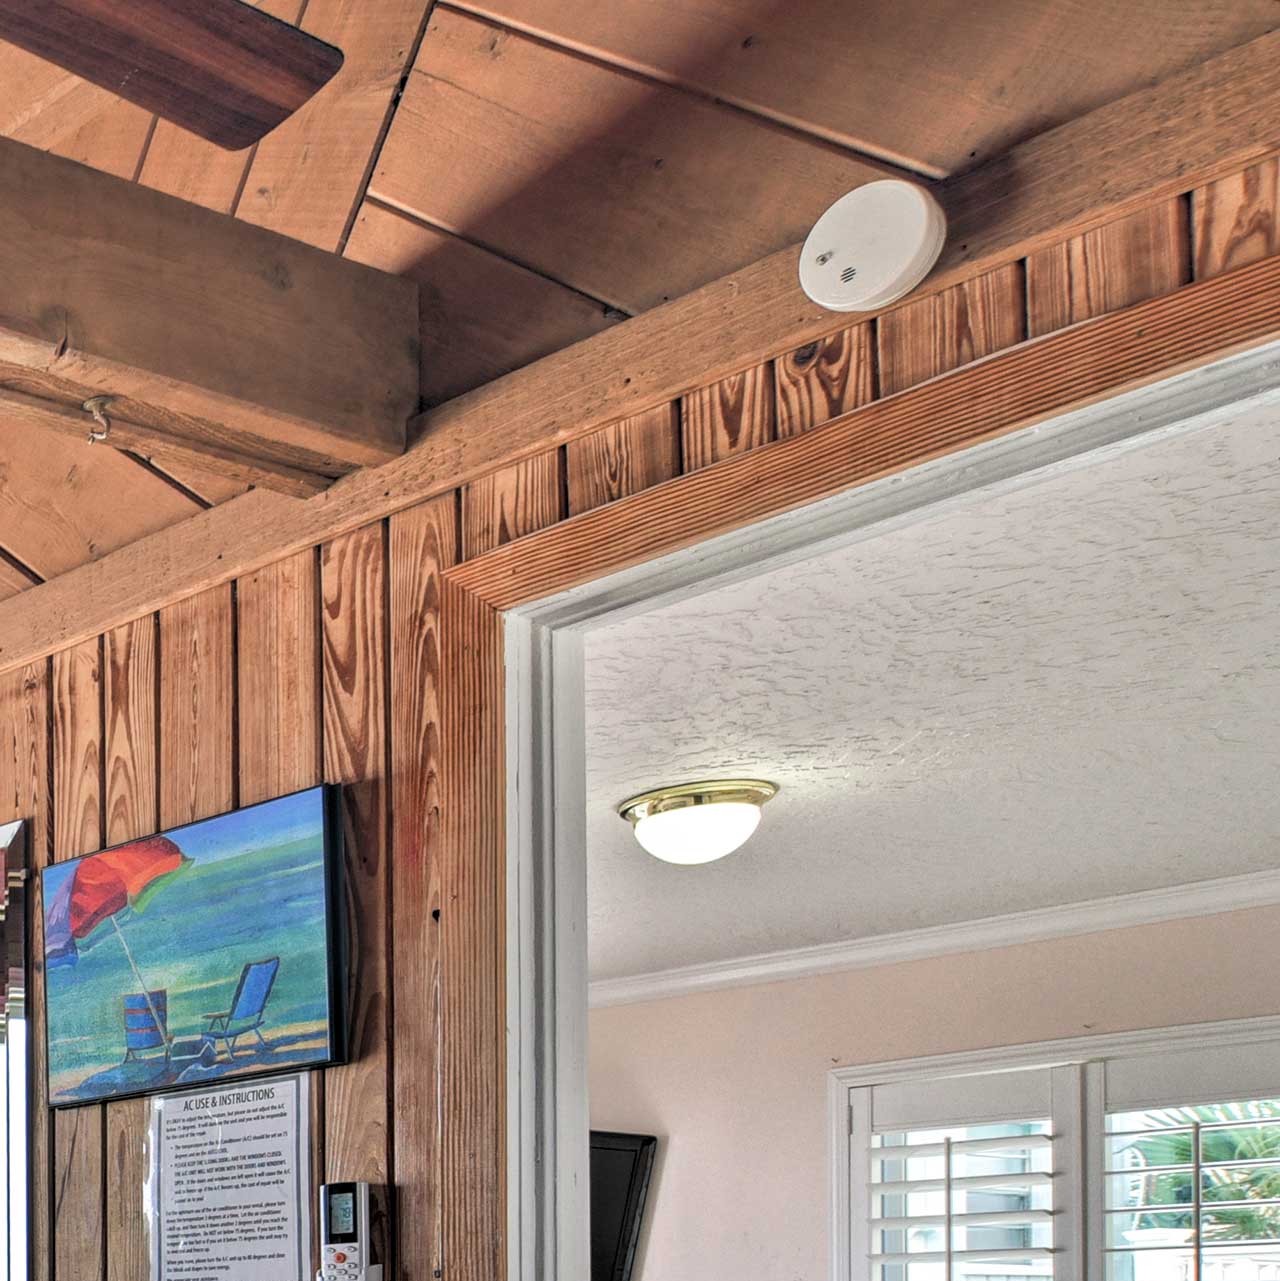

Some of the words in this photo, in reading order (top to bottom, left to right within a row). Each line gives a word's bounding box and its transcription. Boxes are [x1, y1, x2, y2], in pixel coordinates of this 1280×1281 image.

[183, 1100, 194, 1111] AC
[195, 1097, 210, 1110] USE
[211, 1096, 218, 1107] &
[219, 1087, 275, 1107] INSTRUCTIONS
